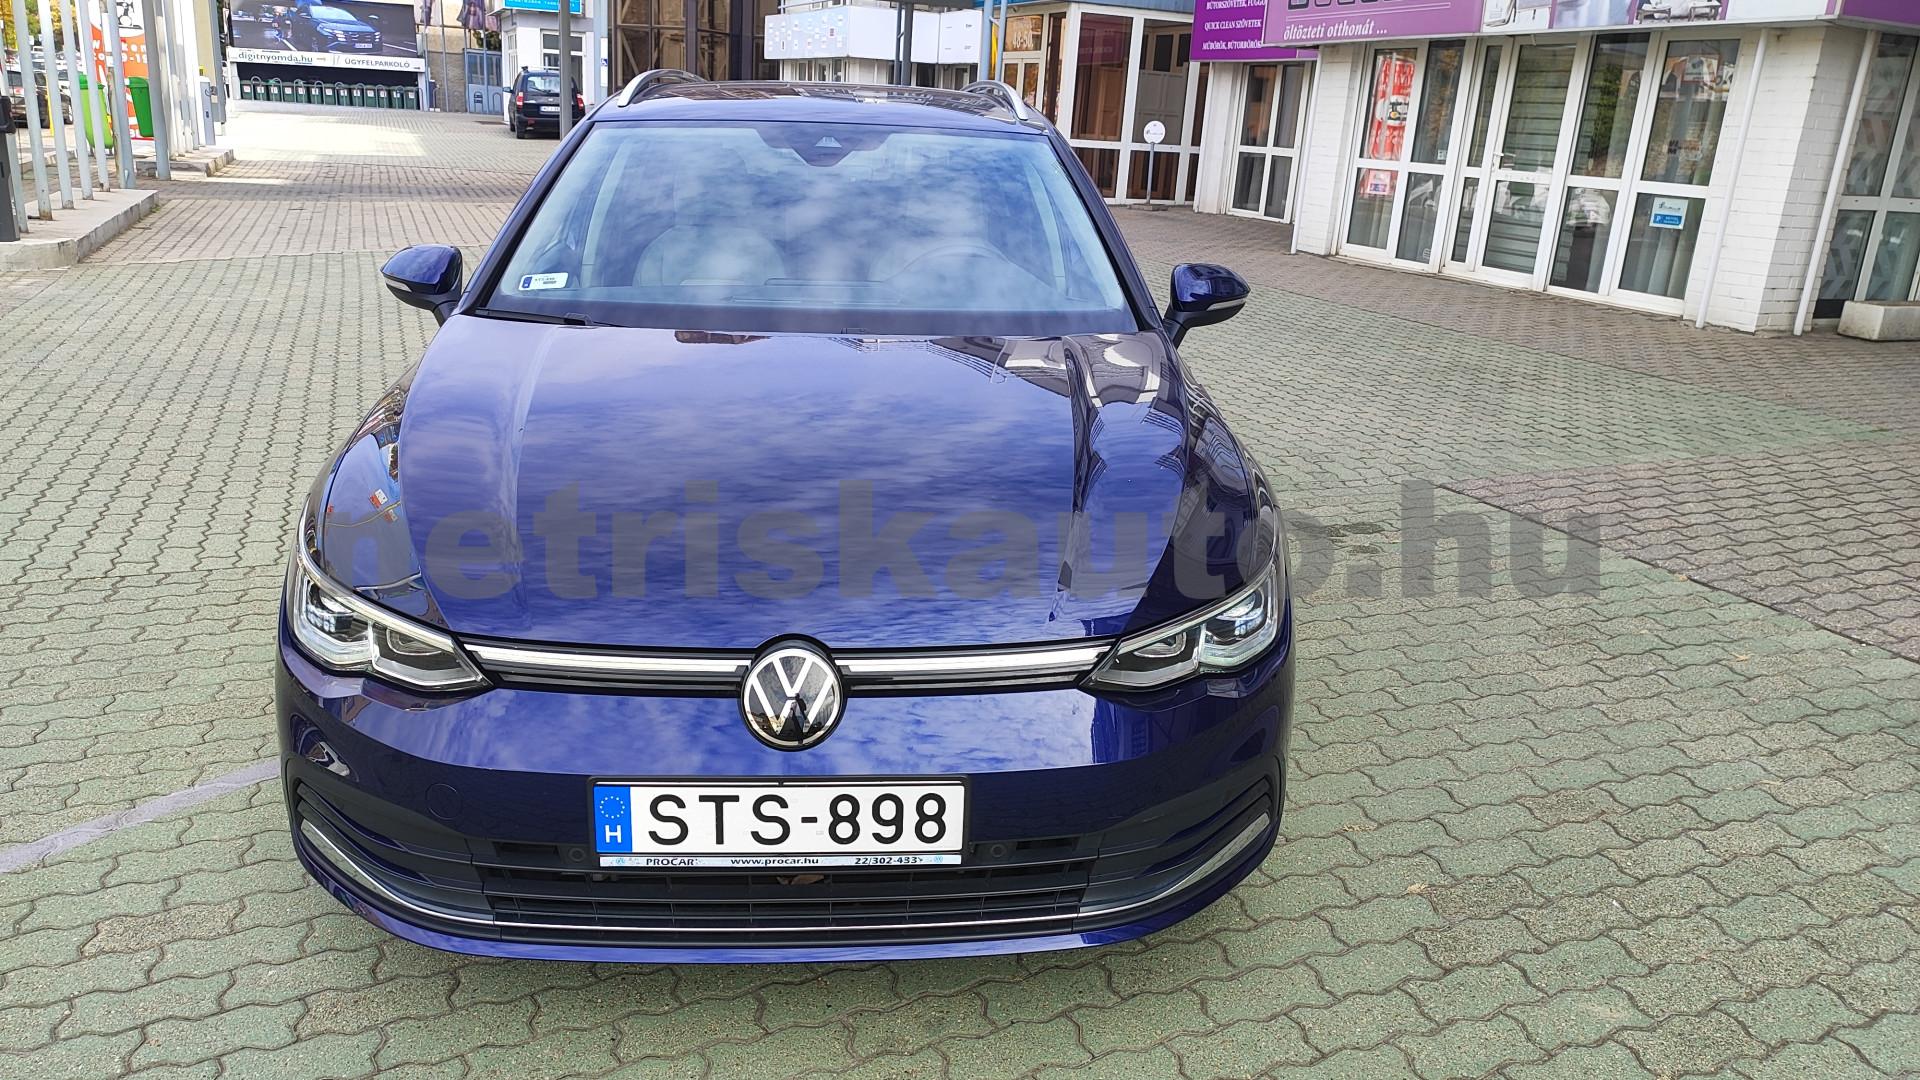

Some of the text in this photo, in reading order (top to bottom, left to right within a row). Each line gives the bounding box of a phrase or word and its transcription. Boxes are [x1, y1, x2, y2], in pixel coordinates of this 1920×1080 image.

[1204, 22, 1220, 31] QUICK
[1220, 21, 1236, 29] CLEAN
[1283, 23, 1325, 41] öltözteti
[1326, 18, 1375, 38] otthonát
[238, 51, 313, 63] digitnyomda.hu
[648, 793, 947, 846] STS-898
[605, 825, 622, 843] H
[646, 857, 695, 866] PROCAR
[731, 856, 819, 866] www.procar.hu
